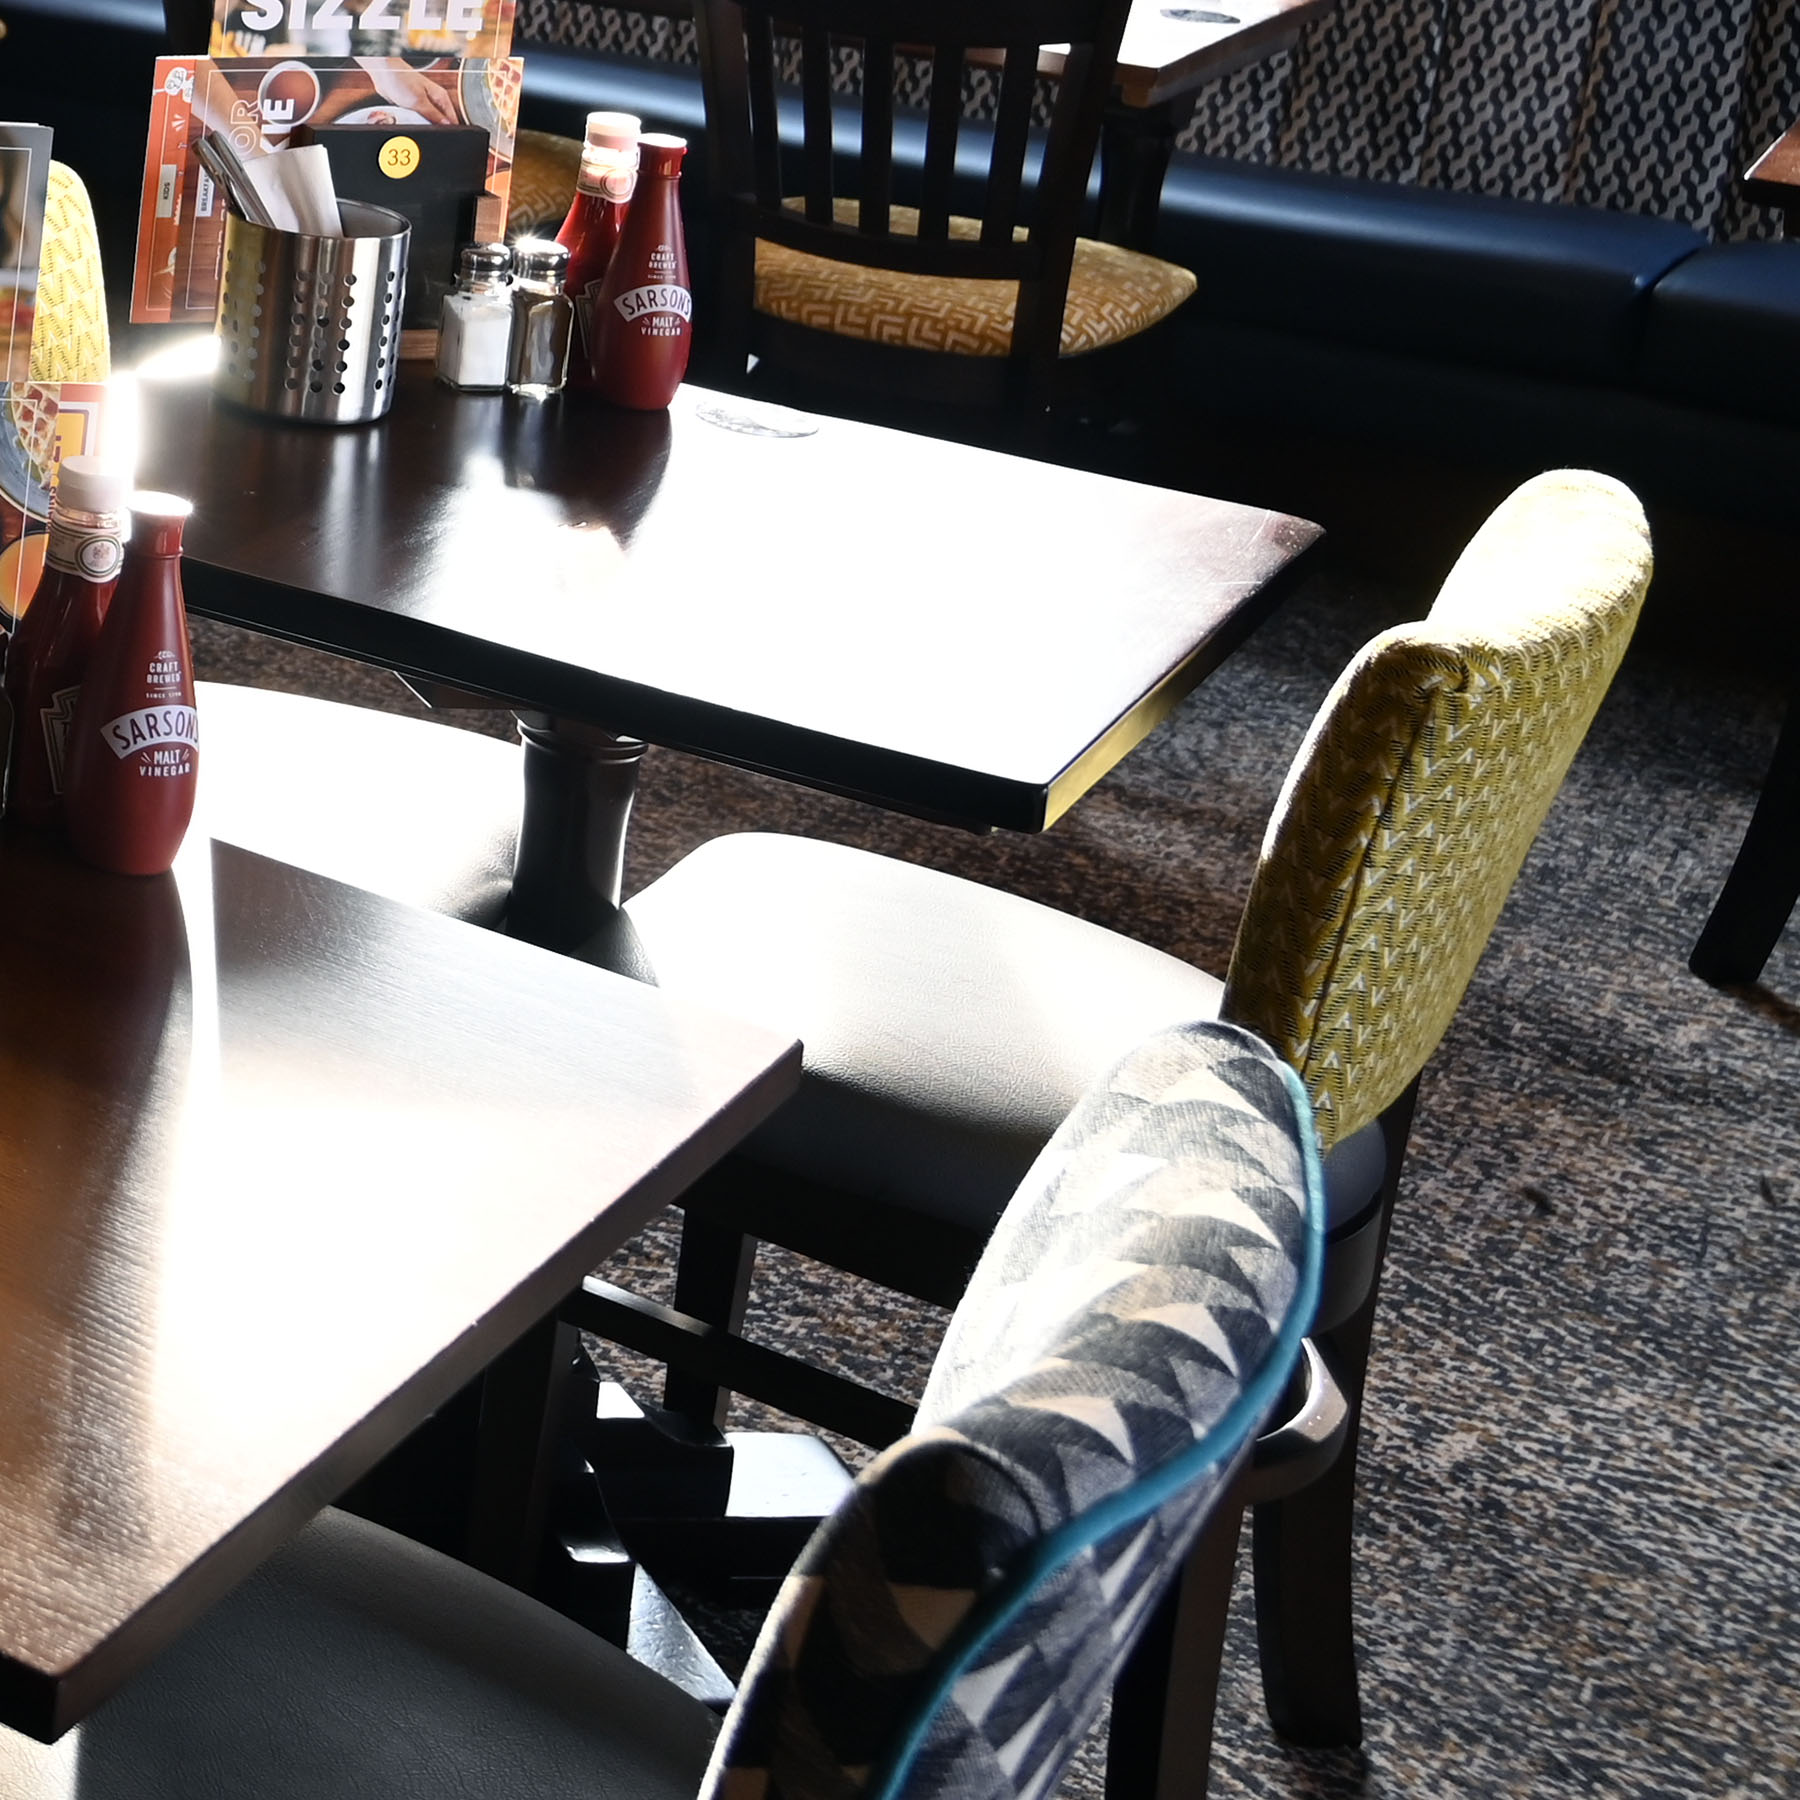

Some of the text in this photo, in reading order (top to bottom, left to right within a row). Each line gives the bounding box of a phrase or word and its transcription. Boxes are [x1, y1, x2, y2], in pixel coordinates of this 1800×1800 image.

[387, 148, 411, 167] 33
[652, 317, 673, 327] MALT
[641, 328, 681, 336] VINEGAR
[149, 661, 178, 673] CRAFT
[146, 673, 180, 684] BREWED
[154, 750, 180, 764] MALT
[140, 763, 191, 777] VINEGAR
